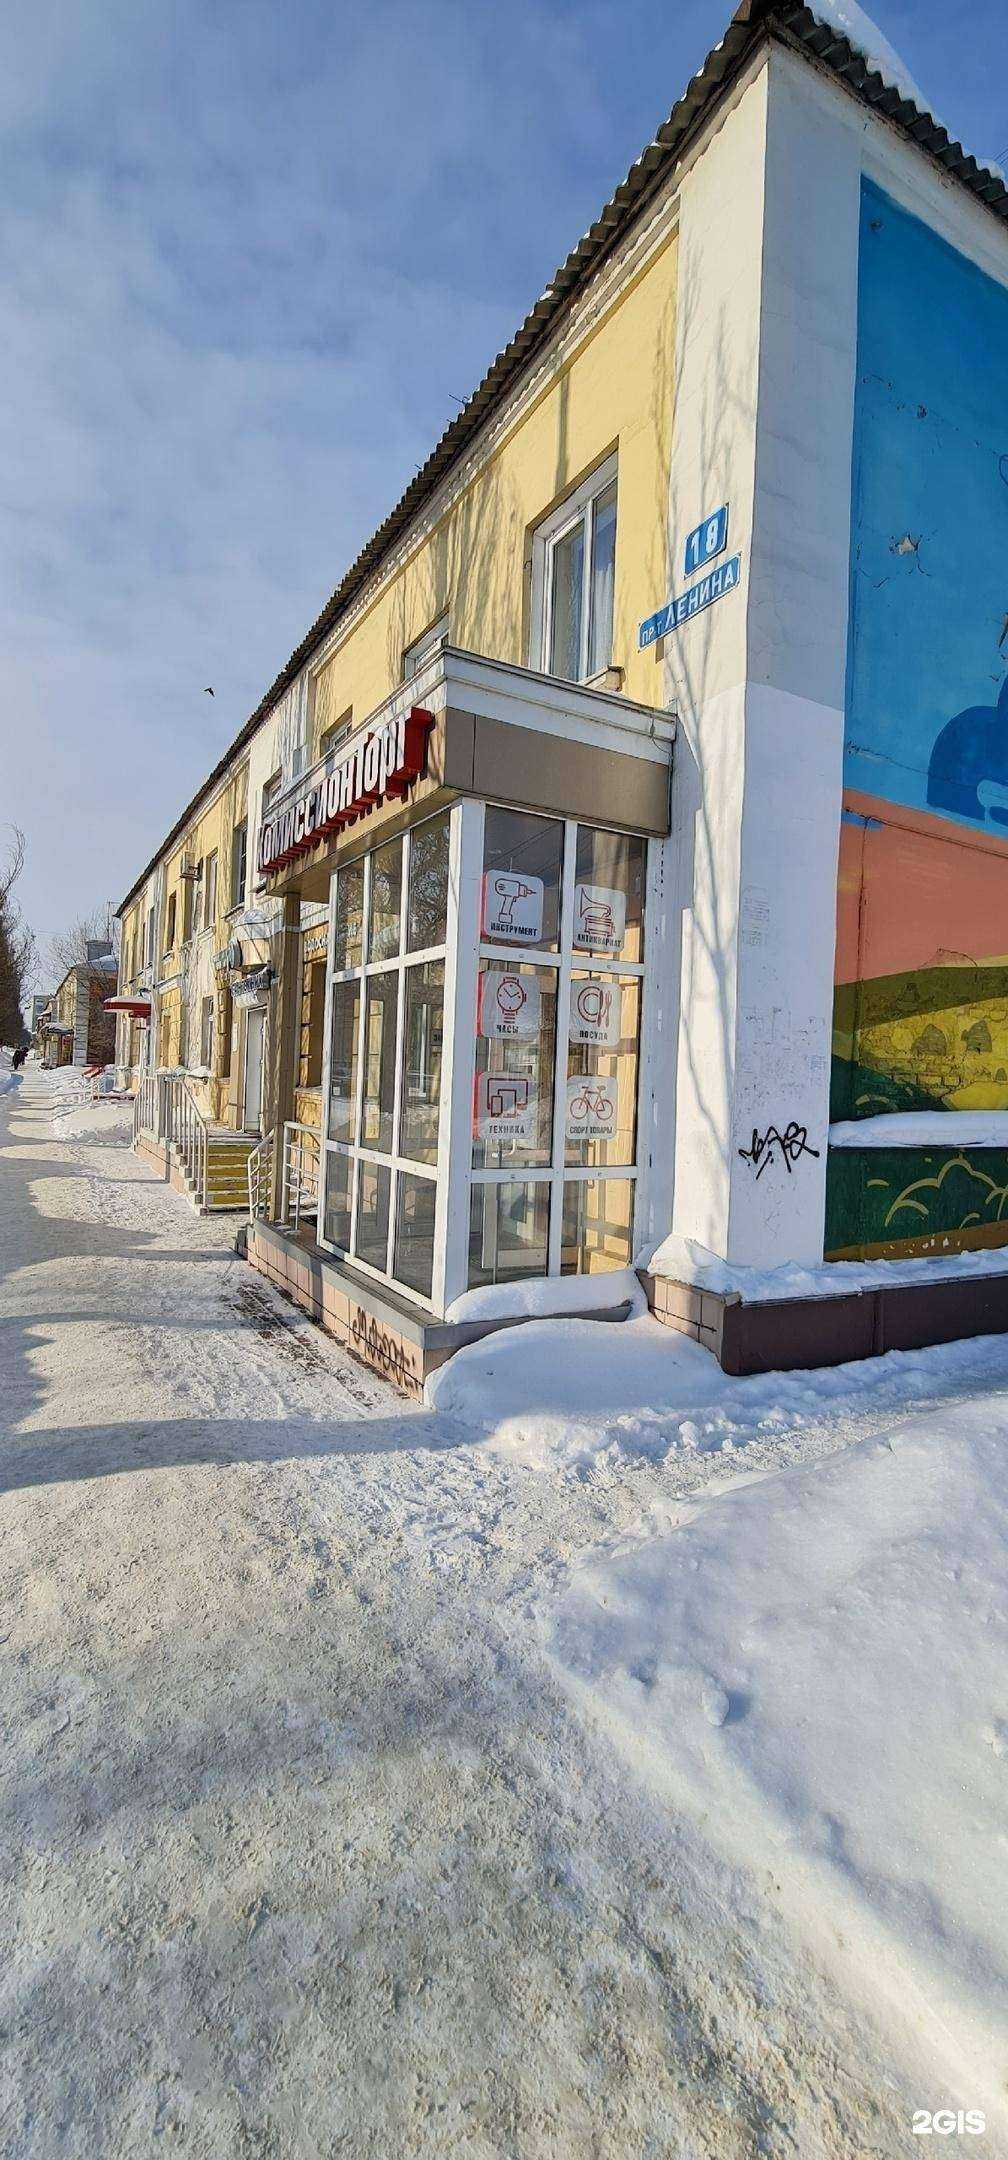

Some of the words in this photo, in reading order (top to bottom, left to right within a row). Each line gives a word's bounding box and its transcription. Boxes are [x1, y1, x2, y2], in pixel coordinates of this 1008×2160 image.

[690, 518, 719, 565] 18
[665, 568, 734, 630] ЛЕНИНА
[490, 922, 538, 937] ИНСТРУМЕНТ
[577, 933, 622, 947] АНТИКВАРИАТ
[496, 1023, 519, 1034] ЧАСЫ
[579, 1030, 609, 1041] ПОСУДА
[488, 1124, 525, 1135] ТЕХНИКА
